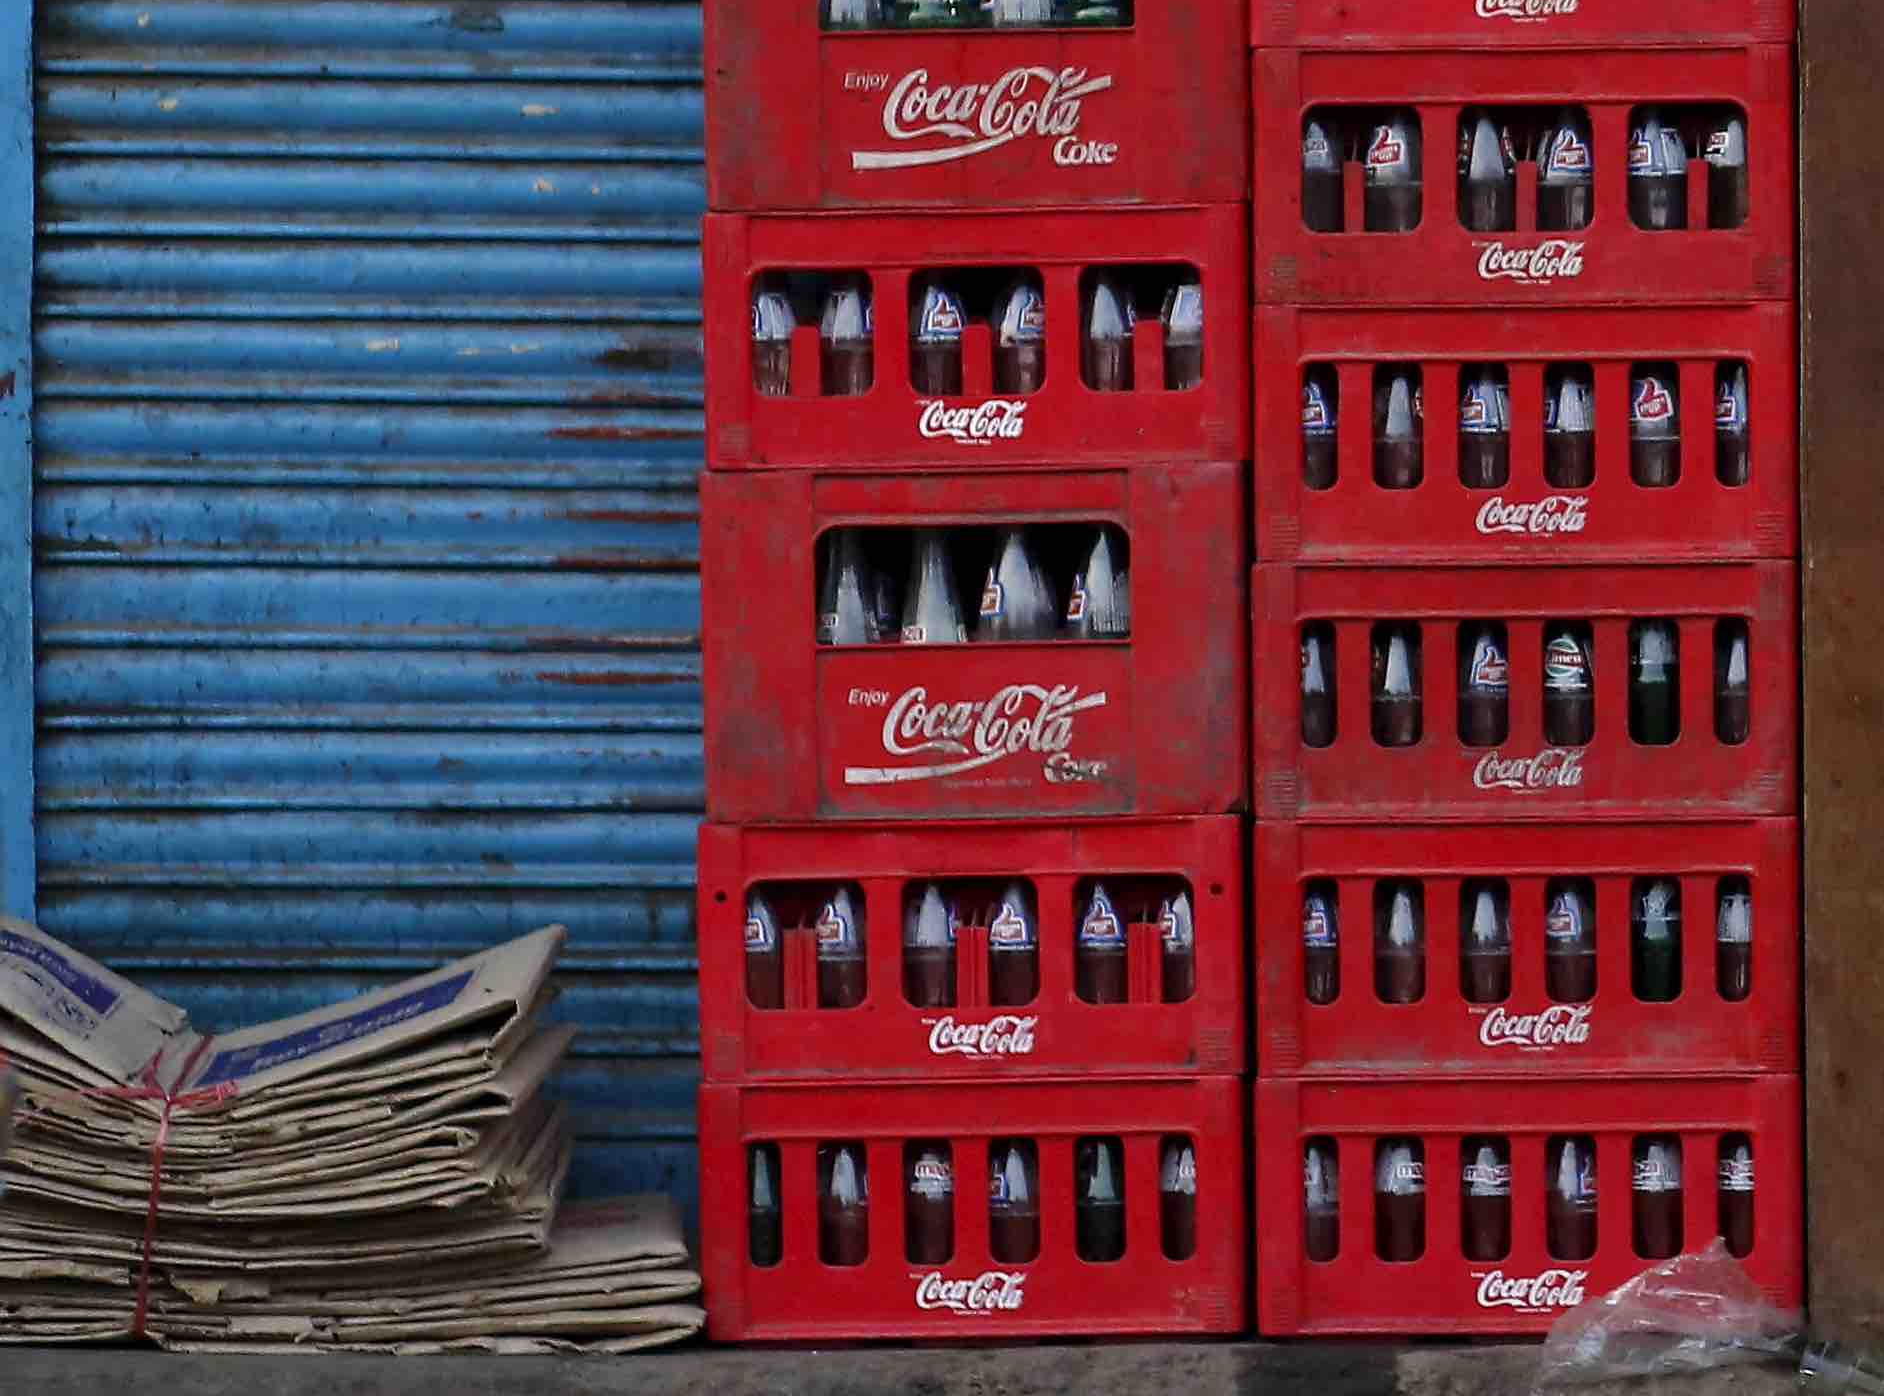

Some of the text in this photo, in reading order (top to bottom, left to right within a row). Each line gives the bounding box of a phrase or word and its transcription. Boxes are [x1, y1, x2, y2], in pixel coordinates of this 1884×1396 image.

[844, 66, 1088, 140] Enjoy Coca-Cola
[1053, 135, 1119, 166] Coke
[1478, 240, 1585, 280] Coca-Cola
[919, 400, 1028, 438] Coca-Cola
[1475, 496, 1589, 534] Coca-Cola
[848, 683, 1080, 756] Enjoy Coca-Cola
[1473, 749, 1586, 790] Coca-Cola
[929, 1015, 1039, 1054] Coca-Cola
[1479, 1005, 1593, 1046] Coca-Cola
[915, 1272, 1027, 1310] Coca-Cola
[1477, 1269, 1588, 1307] Coca-Cola
